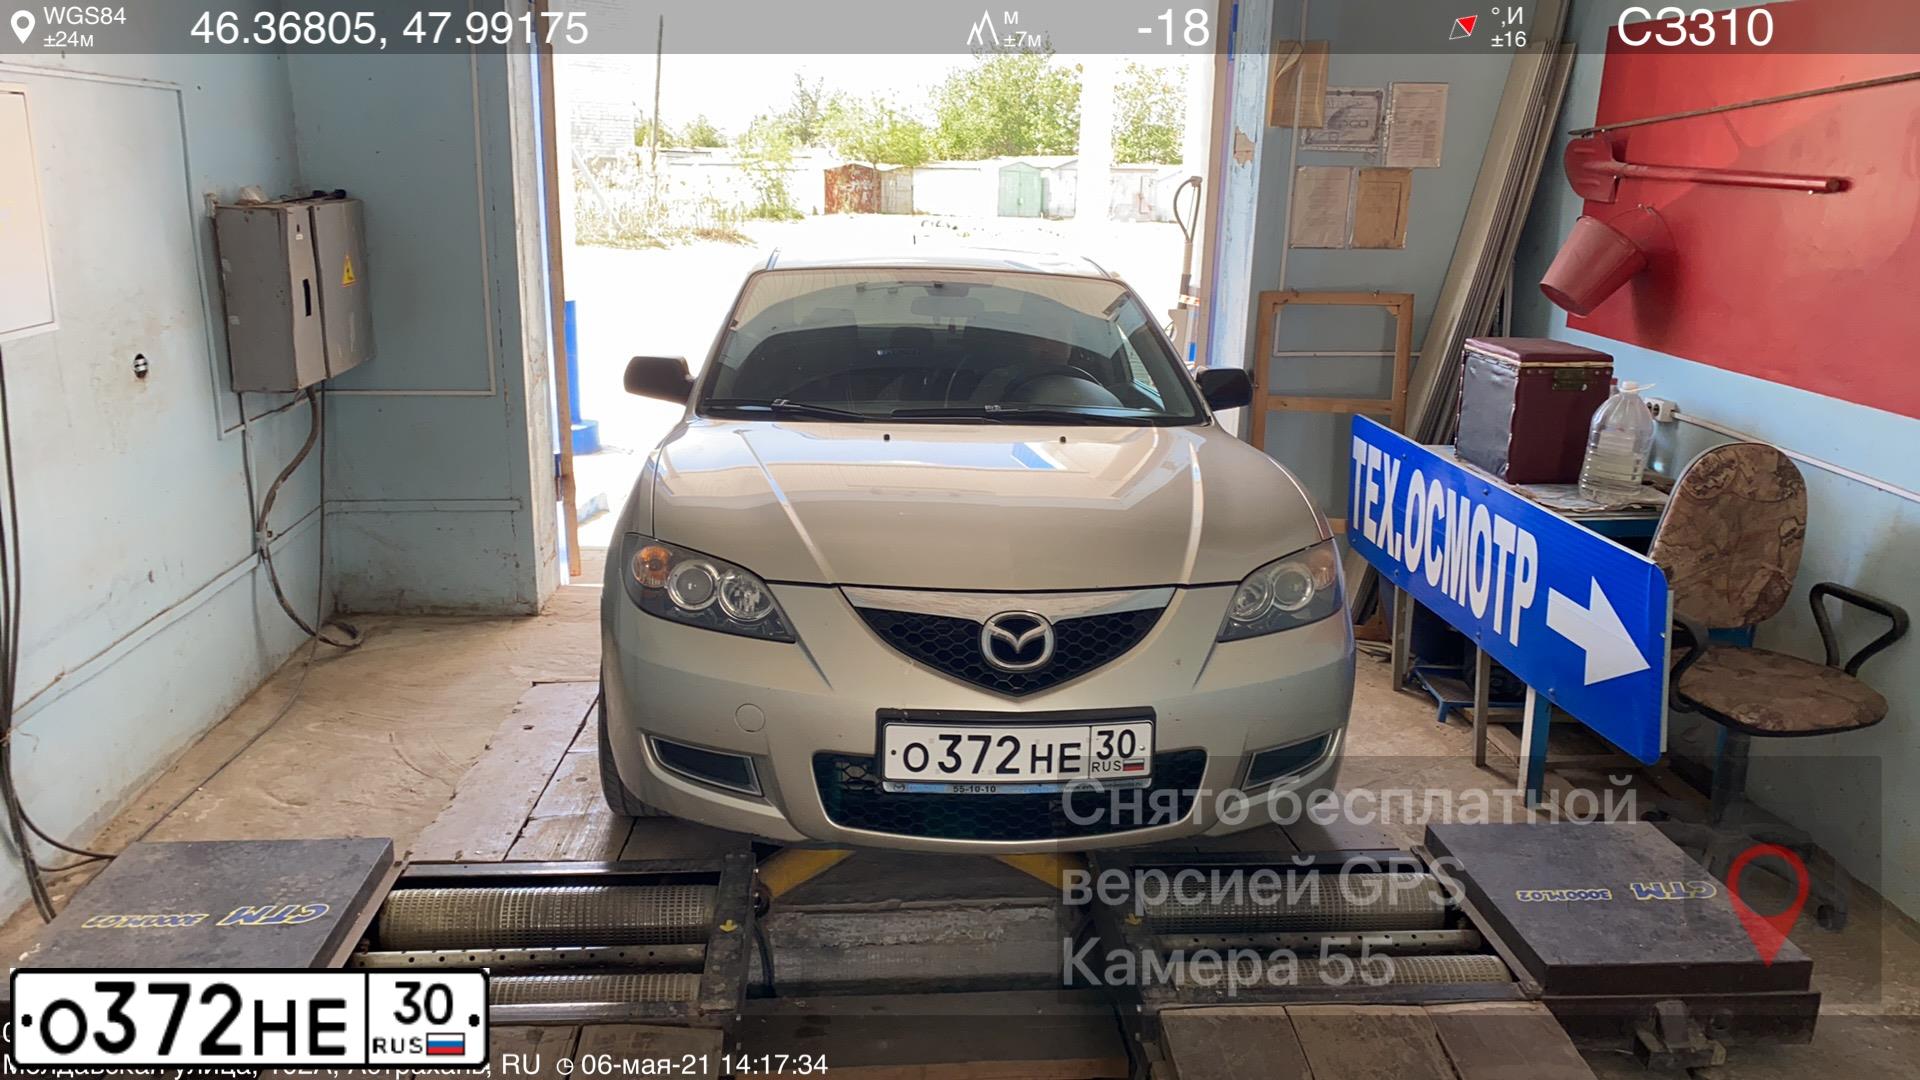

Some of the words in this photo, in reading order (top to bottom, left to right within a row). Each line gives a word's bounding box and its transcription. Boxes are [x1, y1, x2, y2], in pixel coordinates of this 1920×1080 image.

[1352, 435, 1539, 648] ТЕХ.ОСМОТР
[1096, 729, 1137, 759] 30
[1091, 760, 1122, 773] RUS
[952, 784, 998, 794] 55-10-10
